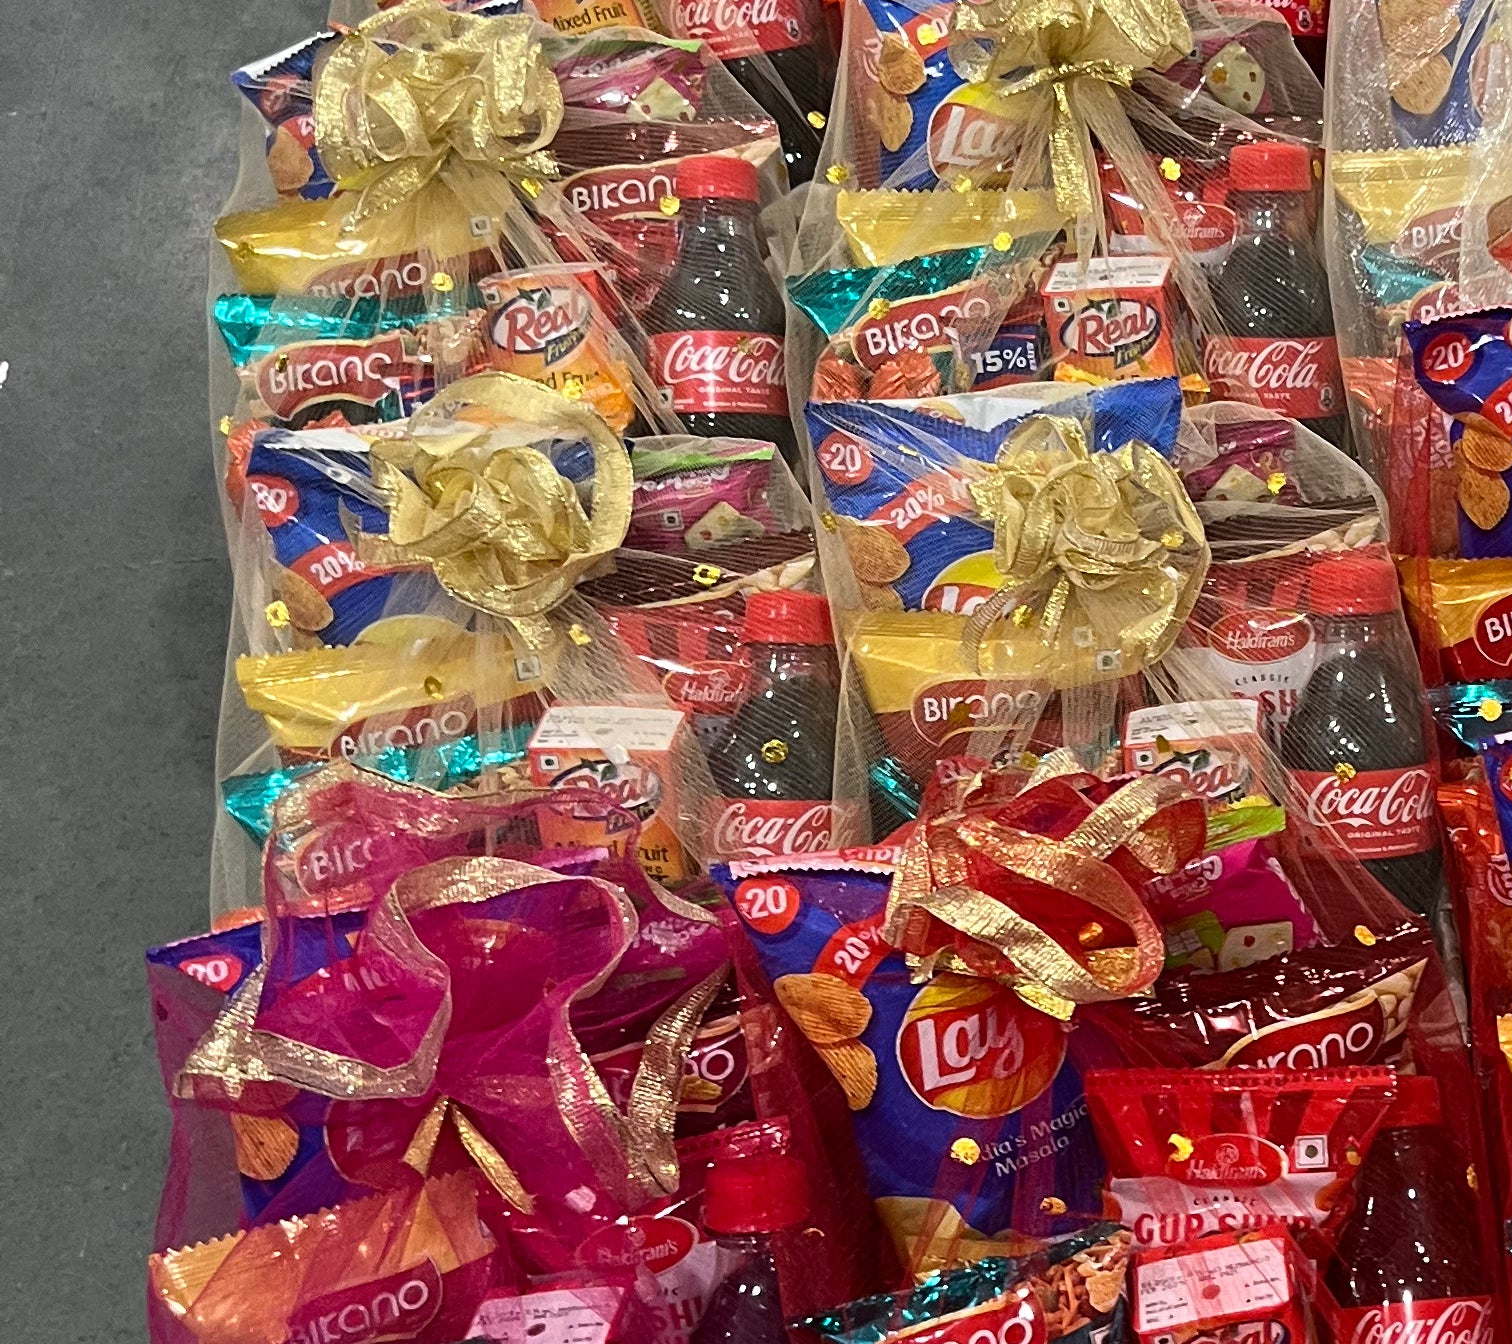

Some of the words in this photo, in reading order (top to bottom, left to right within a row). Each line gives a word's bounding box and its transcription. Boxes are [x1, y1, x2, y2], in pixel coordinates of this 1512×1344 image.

[597, 2, 629, 25] Fruit
[1076, 308, 1152, 358] Real
[1029, 1102, 1092, 1142] Magic
[994, 1134, 1073, 1177] Masala
